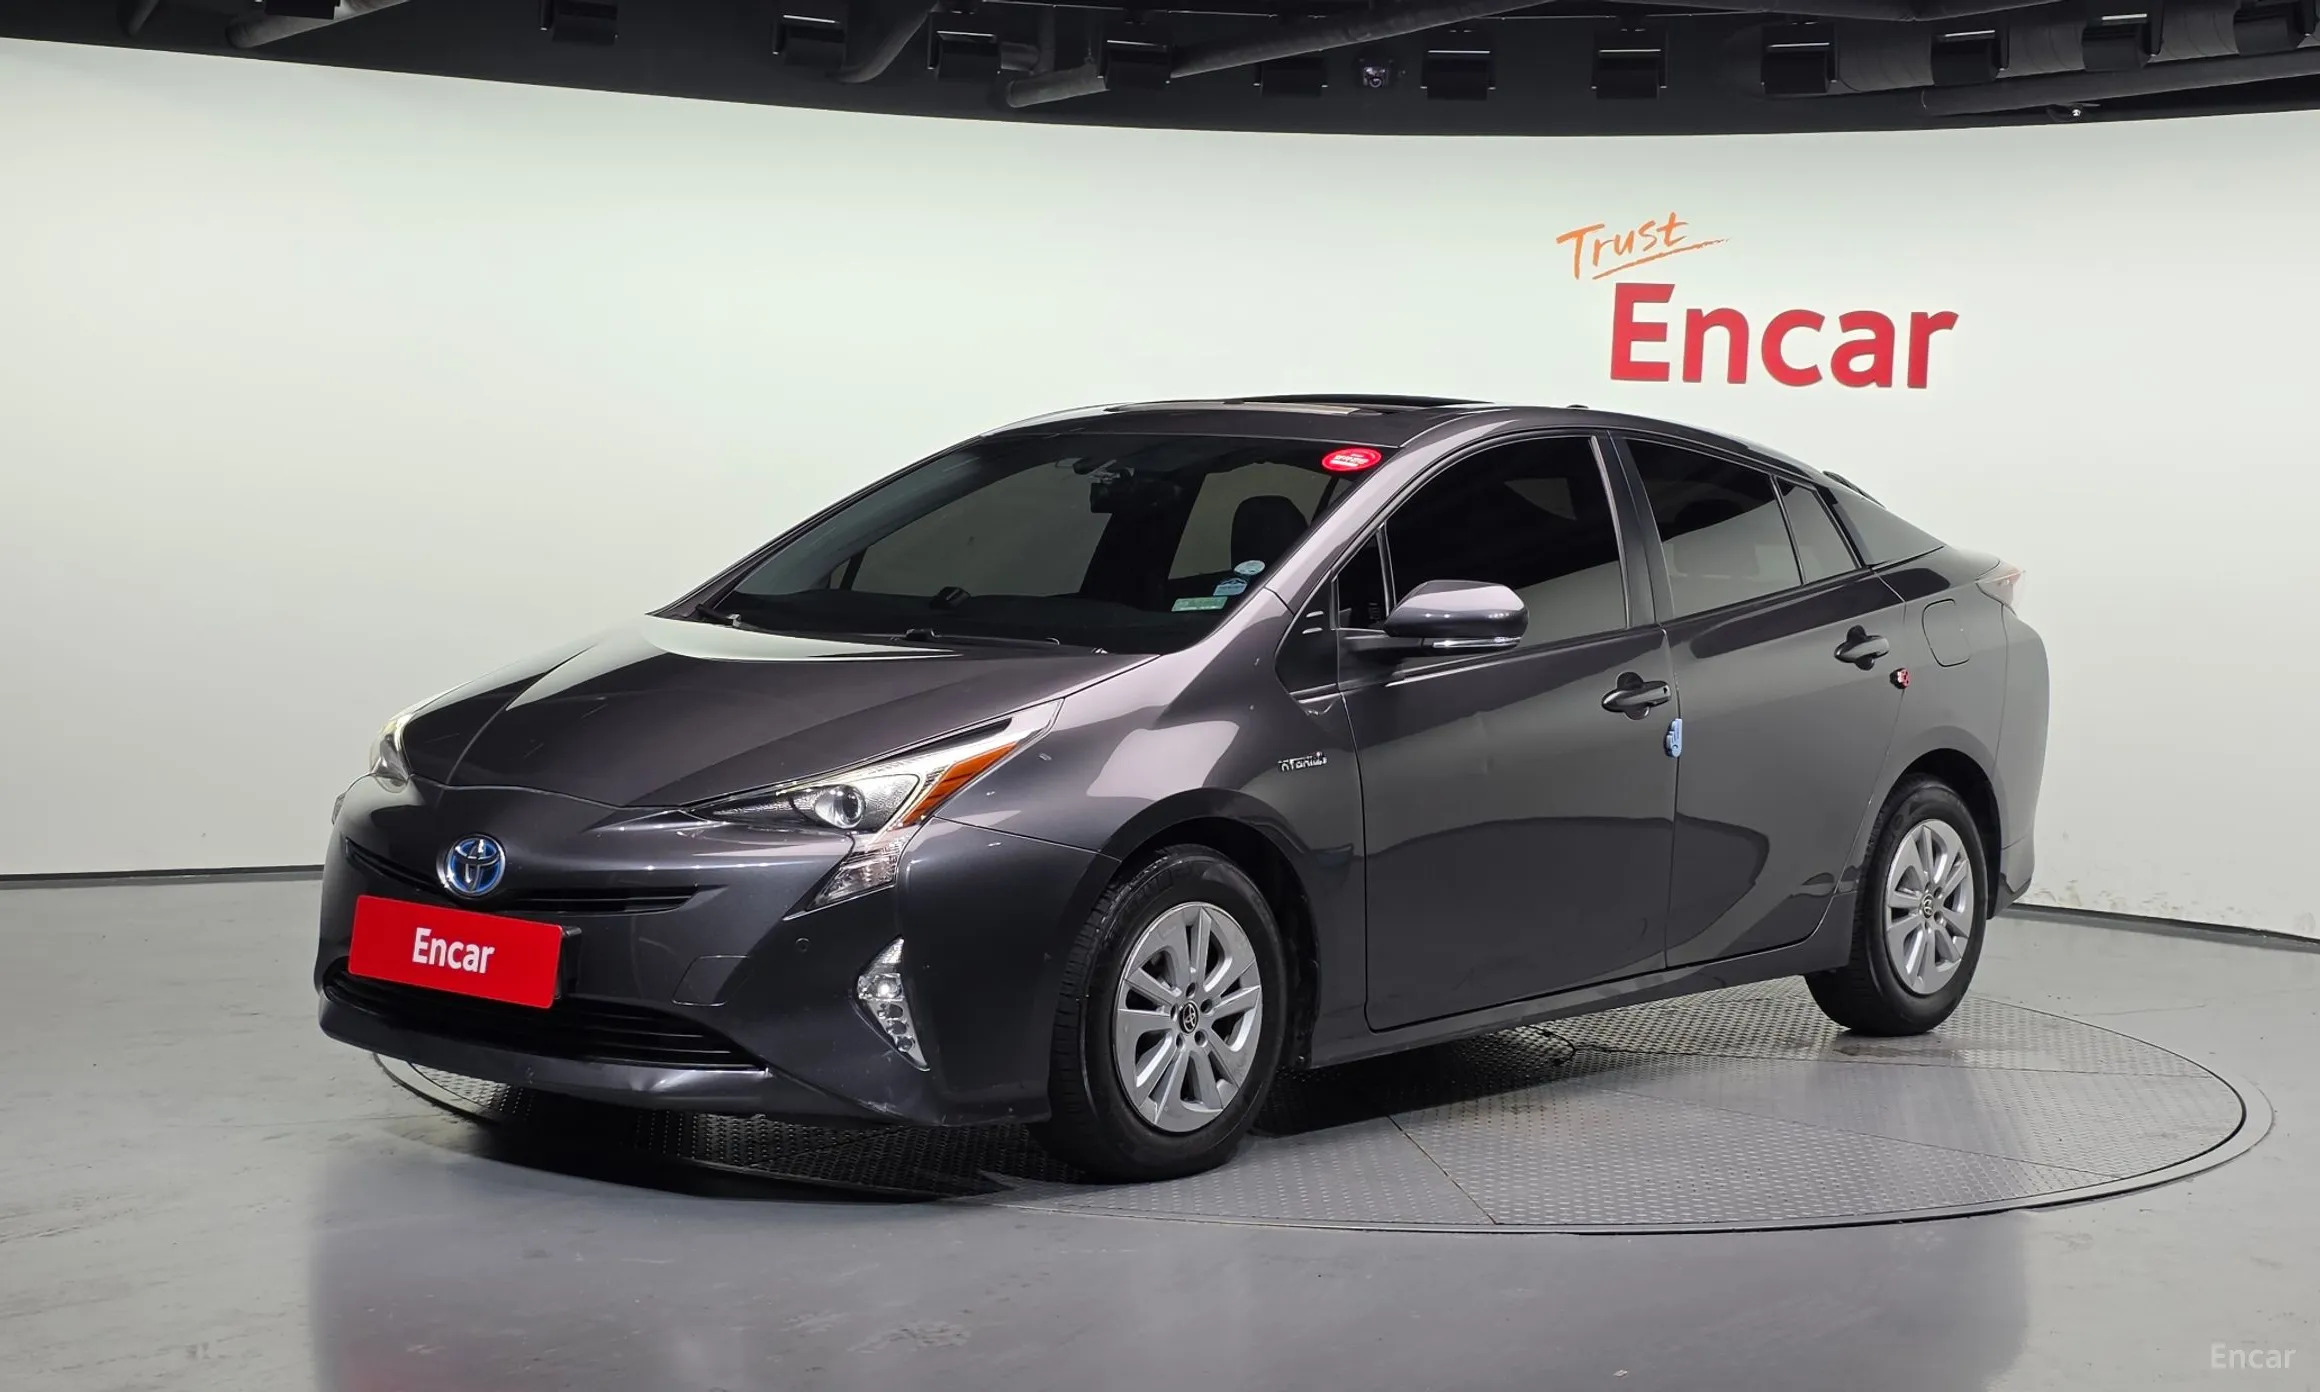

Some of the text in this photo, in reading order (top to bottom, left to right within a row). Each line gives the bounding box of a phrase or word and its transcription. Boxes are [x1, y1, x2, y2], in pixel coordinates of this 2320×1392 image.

[1556, 212, 1688, 279] Trust
[1611, 283, 1959, 389] Encar
[412, 927, 495, 974] Encar
